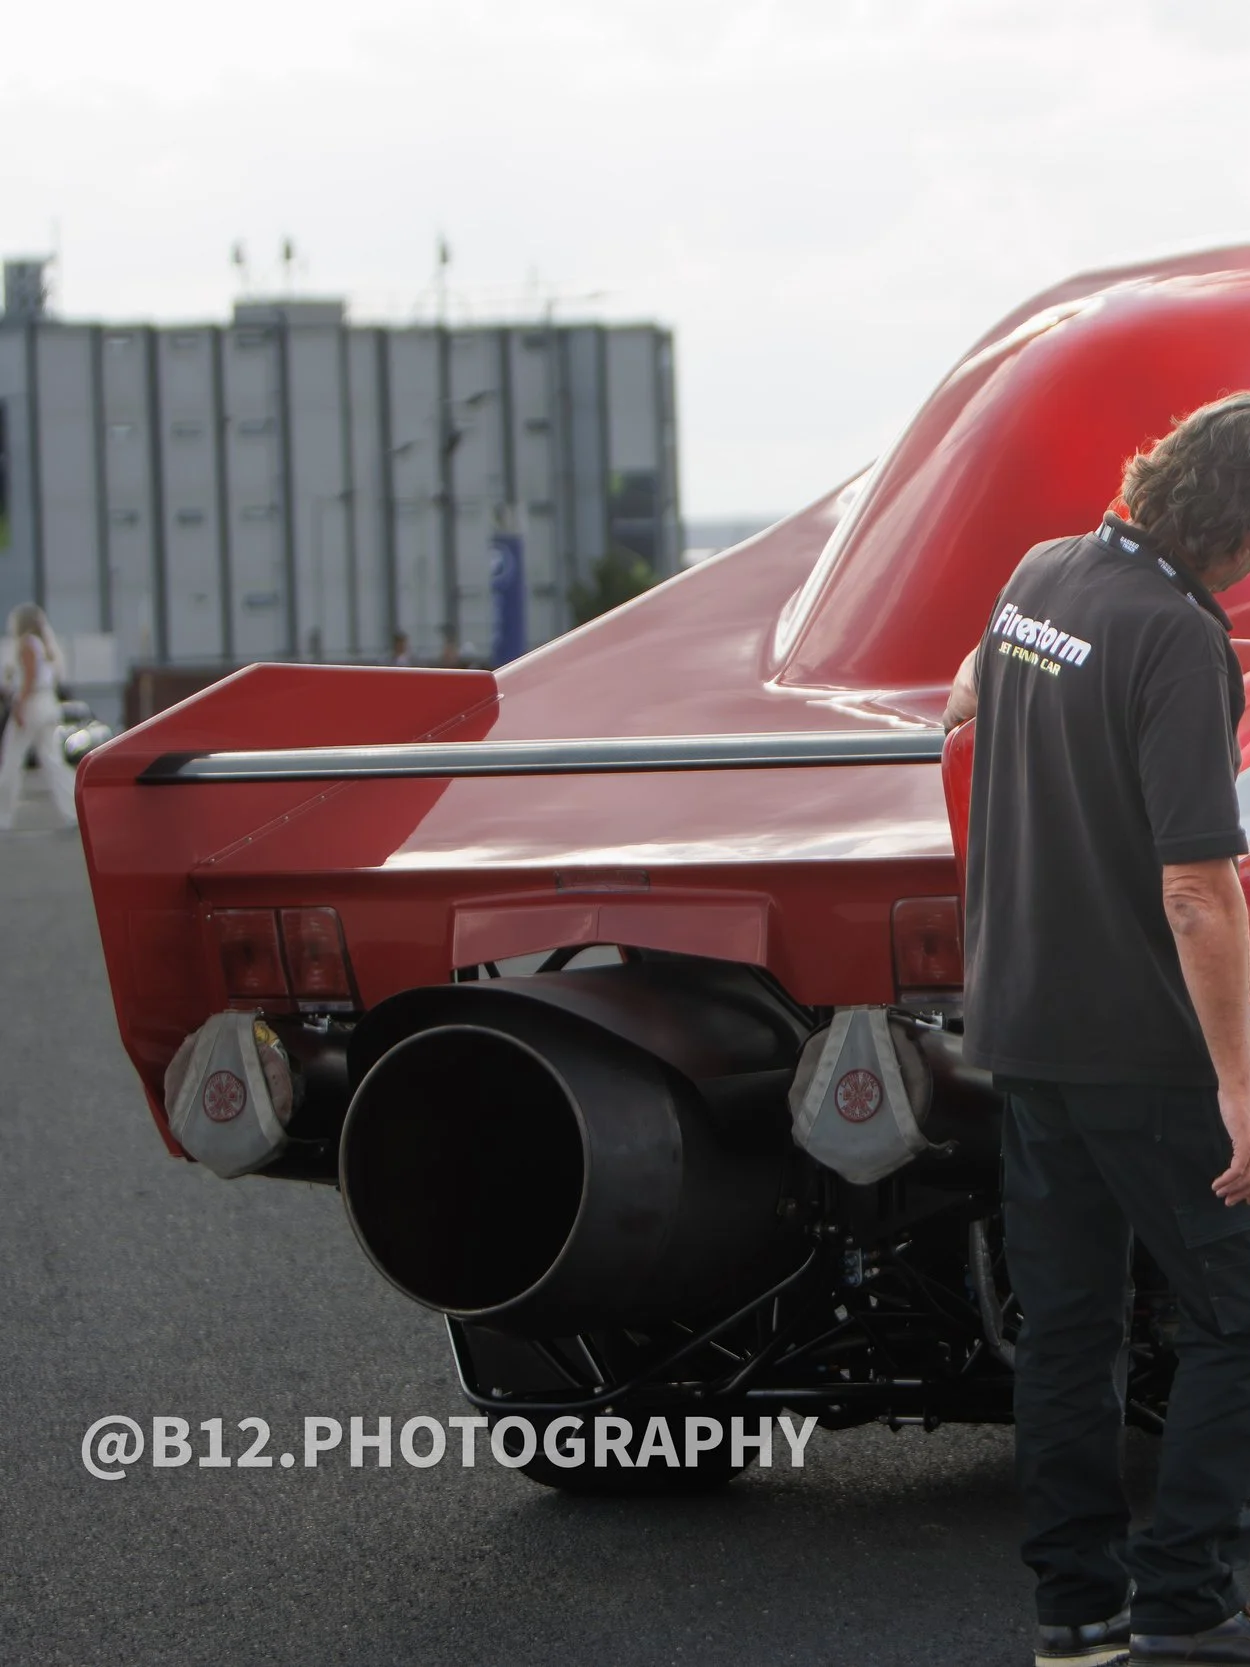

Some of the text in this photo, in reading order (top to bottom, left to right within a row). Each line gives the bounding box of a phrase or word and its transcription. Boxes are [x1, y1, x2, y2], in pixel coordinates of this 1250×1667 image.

[993, 603, 1092, 667] Firestorm
[999, 641, 1012, 655] JET
[1040, 658, 1061, 676] CAR
